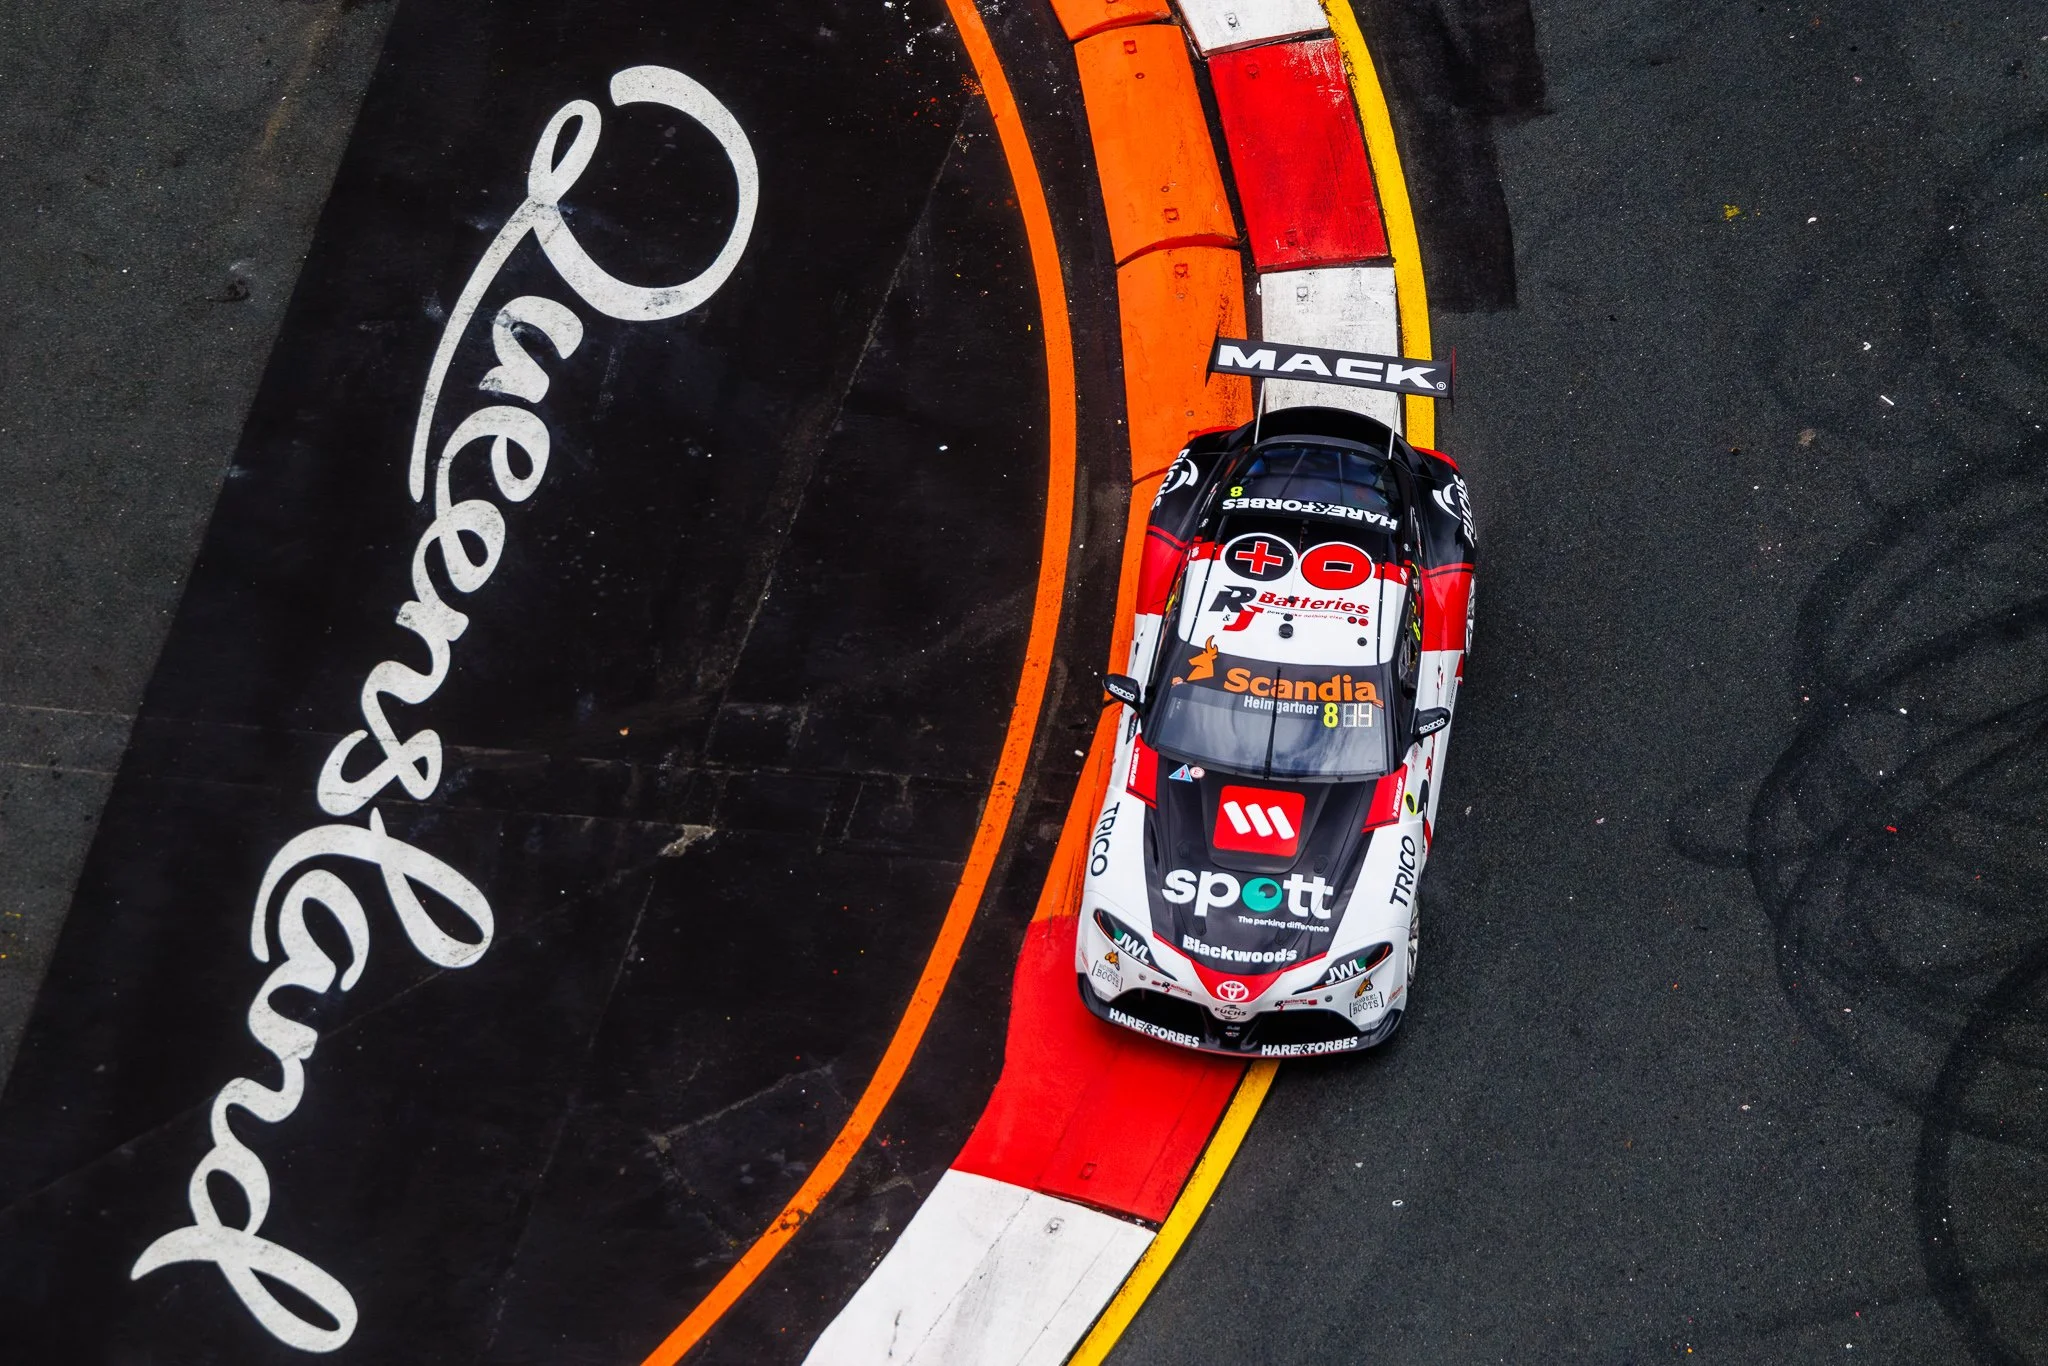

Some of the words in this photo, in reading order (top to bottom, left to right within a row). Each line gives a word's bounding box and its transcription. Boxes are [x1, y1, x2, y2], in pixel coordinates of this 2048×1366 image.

[1218, 345, 1436, 389] MACK
[1230, 486, 1243, 497] 8
[1222, 498, 1397, 531] HARE&FORBES
[1453, 474, 1476, 548] FUCHS
[1208, 585, 1257, 613] R
[1258, 591, 1370, 615] Batteries
[1109, 683, 1136, 701] sparco
[1223, 667, 1379, 702] Scandia
[131, 65, 759, 1353] Queensland
[1243, 695, 1320, 715] Heimgartner
[1323, 702, 1339, 728] 8
[1419, 717, 1446, 734] sparco
[1090, 801, 1120, 876] TRICO
[1389, 835, 1416, 907] TRICO
[1162, 869, 1334, 920] spott
[1238, 916, 1253, 925] The
[1254, 918, 1286, 929] parking
[1287, 921, 1330, 933] difference
[1113, 932, 1150, 963] JWL
[1182, 934, 1298, 963] Blackwoods
[1325, 959, 1367, 986] JWL
[1214, 1006, 1247, 1017] FUCHS
[1108, 1007, 1200, 1048] HARE&FORBES
[1261, 1036, 1358, 1056] HARE&FORBES
